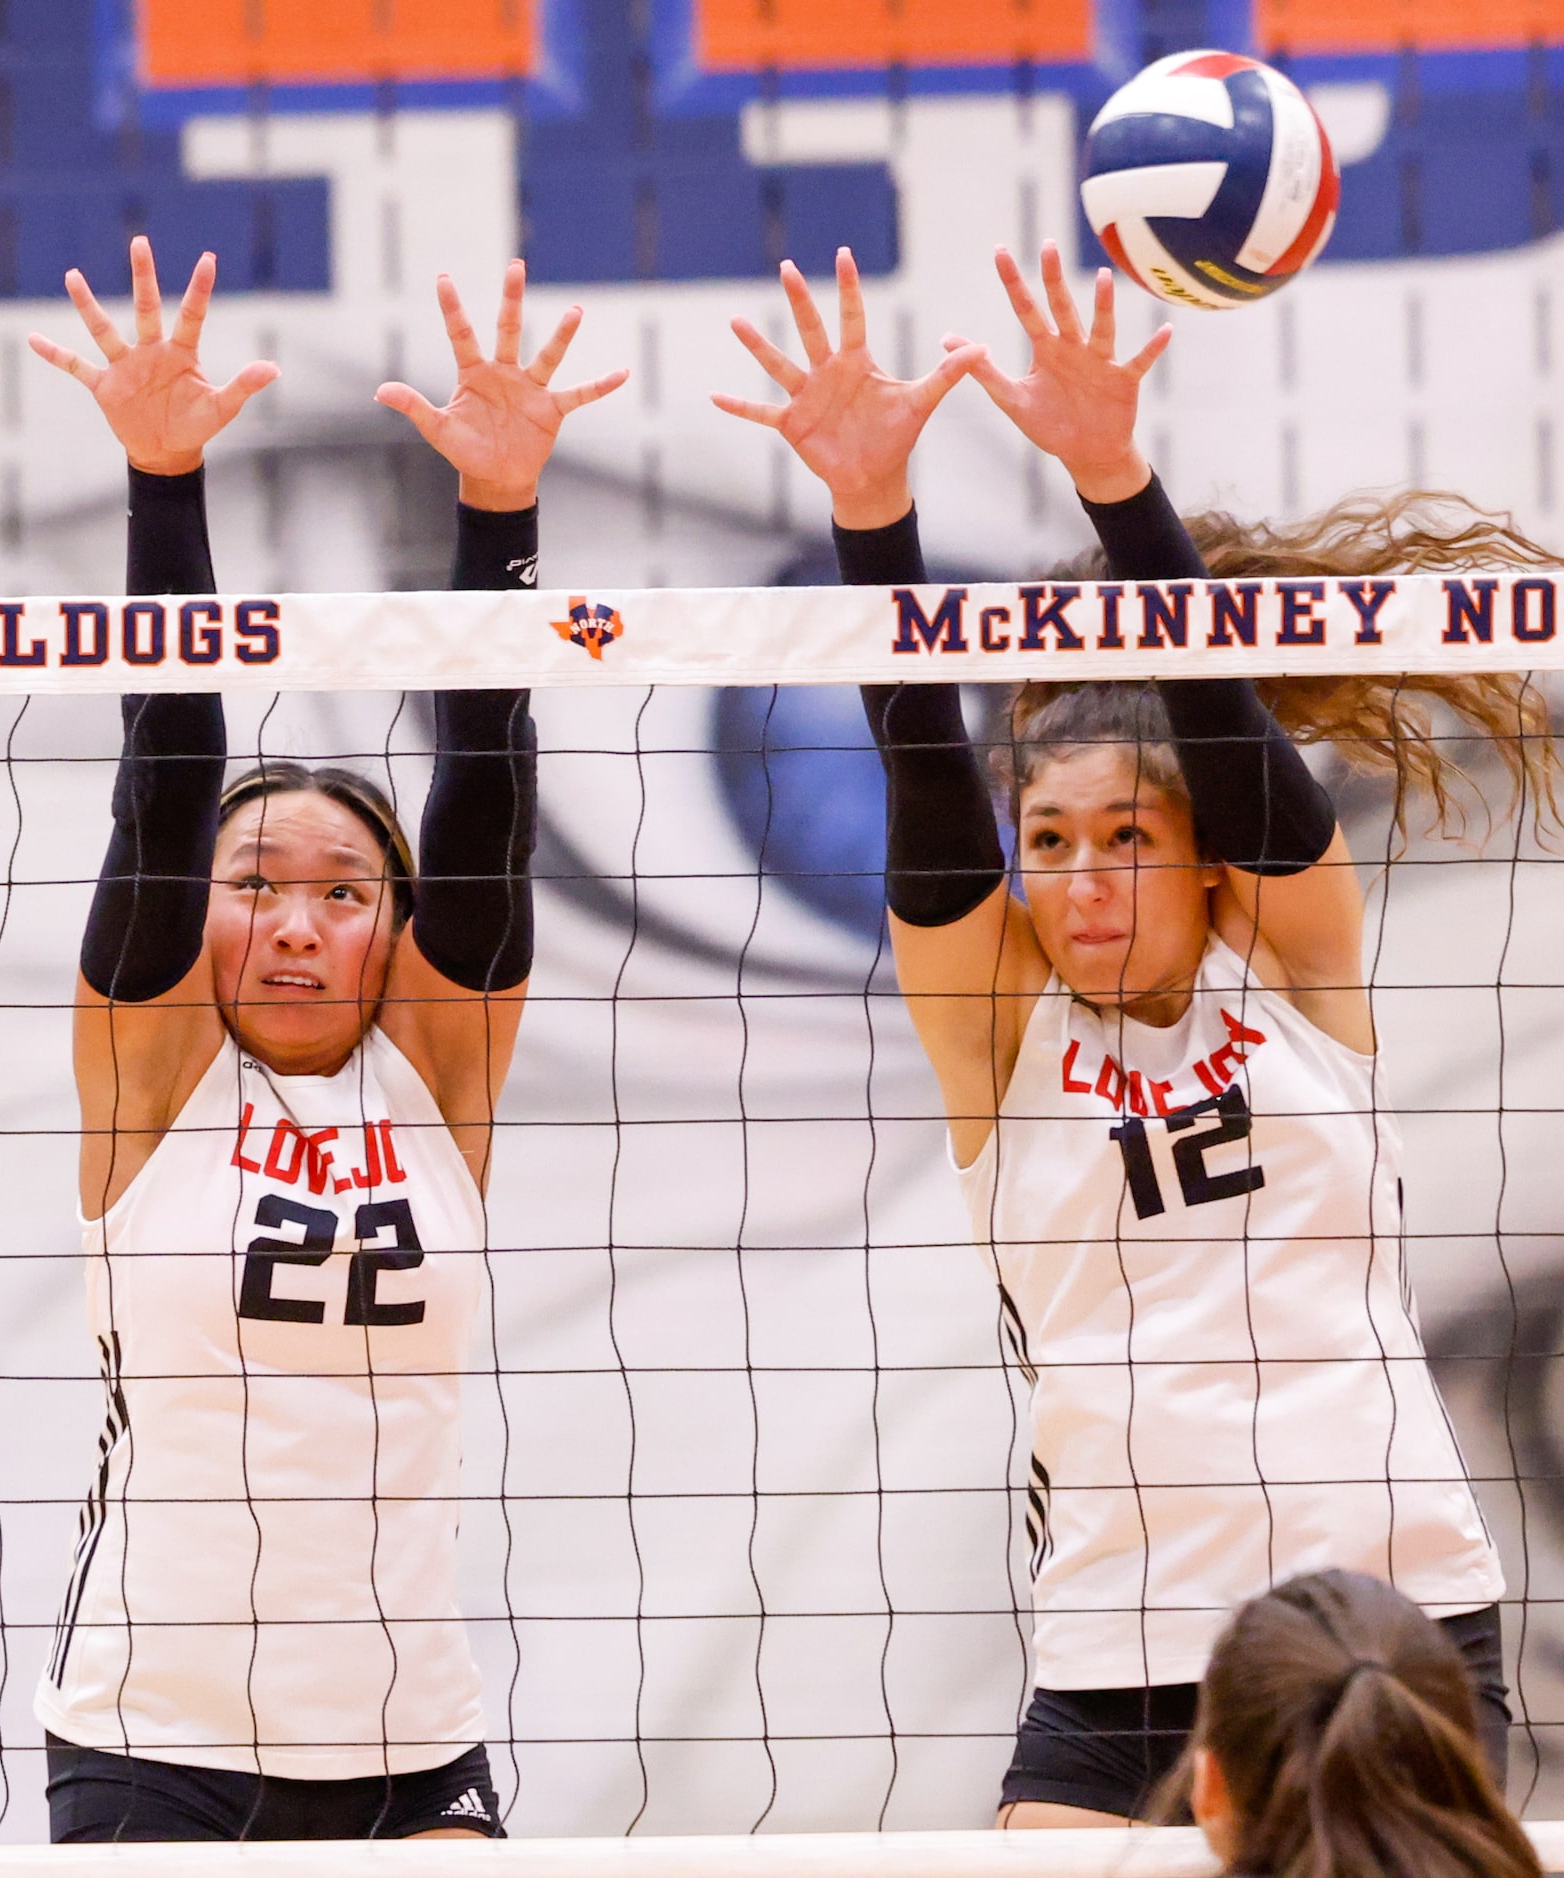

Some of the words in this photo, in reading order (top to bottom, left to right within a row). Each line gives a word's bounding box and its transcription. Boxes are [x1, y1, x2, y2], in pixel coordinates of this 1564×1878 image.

[569, 617, 614, 635] NORTH
[1441, 578, 1558, 644] NO
[1109, 1083, 1266, 1220] 12
[238, 1193, 426, 1326] 22
